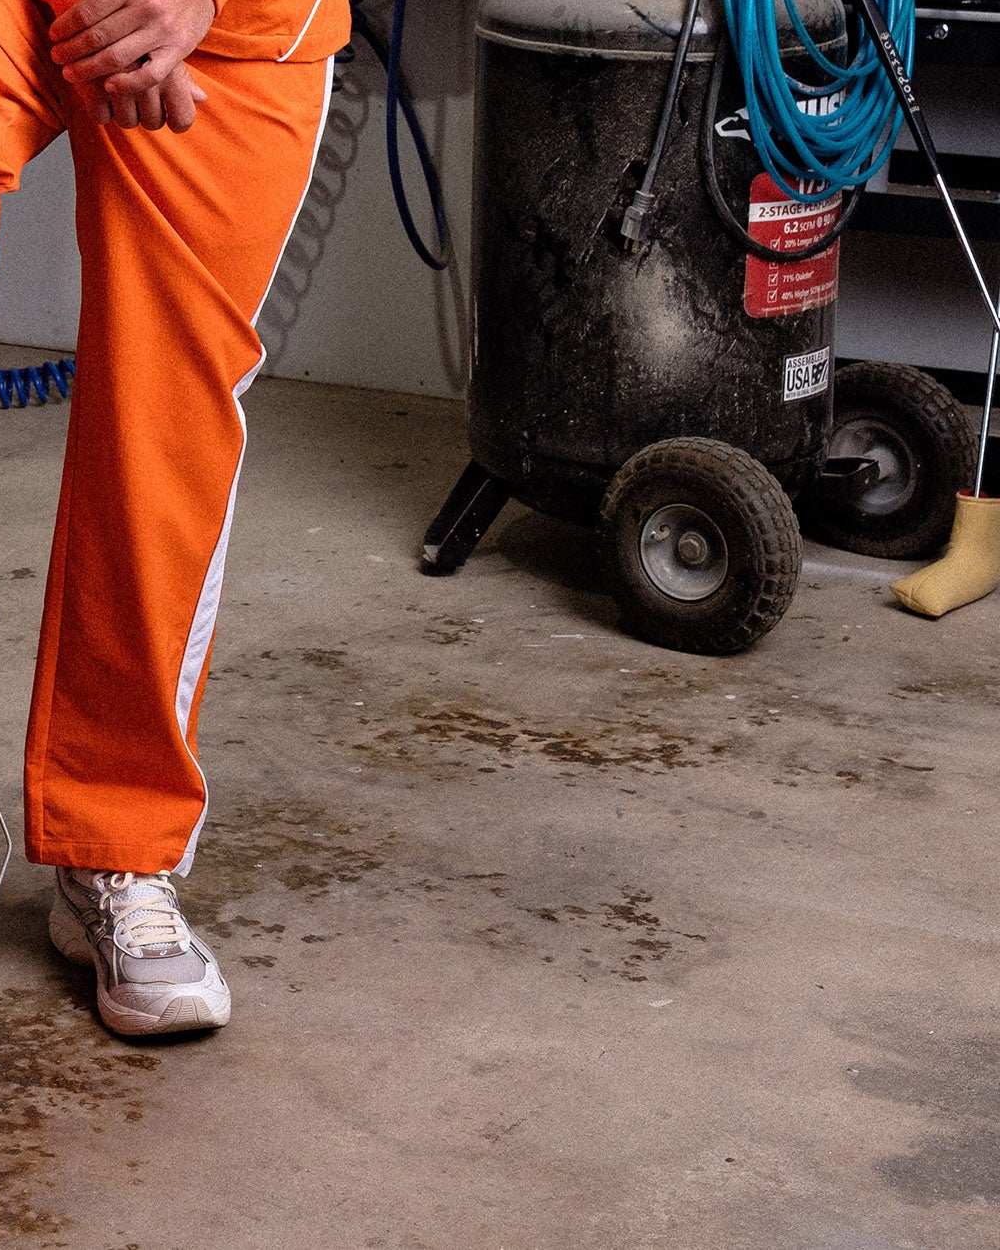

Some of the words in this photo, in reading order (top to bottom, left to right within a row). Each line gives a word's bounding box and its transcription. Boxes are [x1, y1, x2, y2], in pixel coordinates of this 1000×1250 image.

[759, 204, 802, 218] 2-STAGE
[784, 221, 799, 234] 6.2
[800, 220, 815, 232] SCFM
[787, 351, 824, 369] ASSEMBLED
[786, 366, 810, 392] USA
